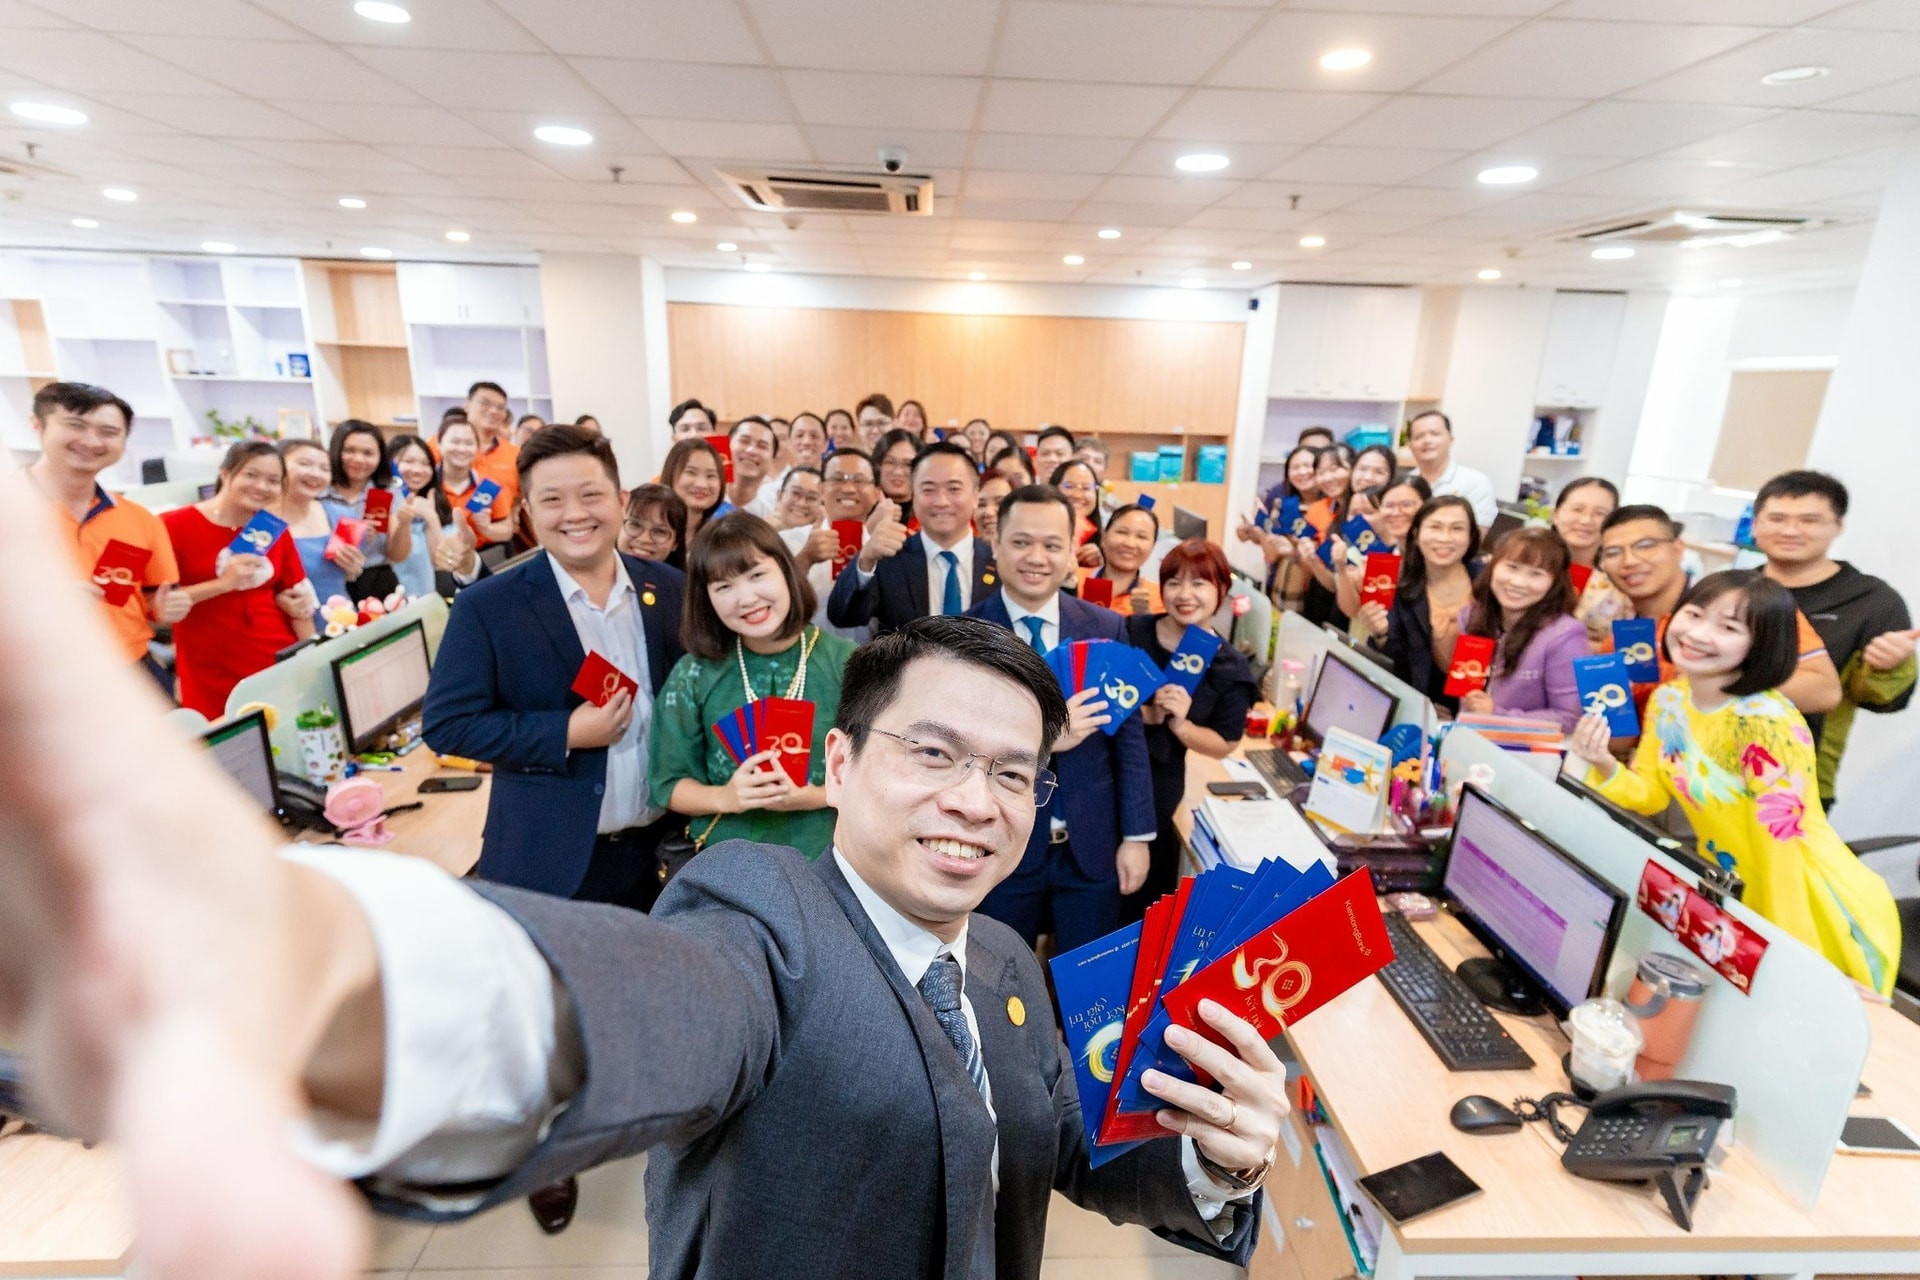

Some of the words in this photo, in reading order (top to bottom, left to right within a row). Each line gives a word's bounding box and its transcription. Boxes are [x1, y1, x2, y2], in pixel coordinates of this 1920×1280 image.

[1171, 653, 1204, 674] 30
[1620, 642, 1654, 665] 30
[1104, 677, 1139, 709] 30
[1584, 684, 1627, 714] 30
[1344, 899, 1366, 954] KienlongBank
[1232, 930, 1312, 1024] 30
[1069, 1012, 1084, 1028] trị
[1084, 1013, 1102, 1033] nối
